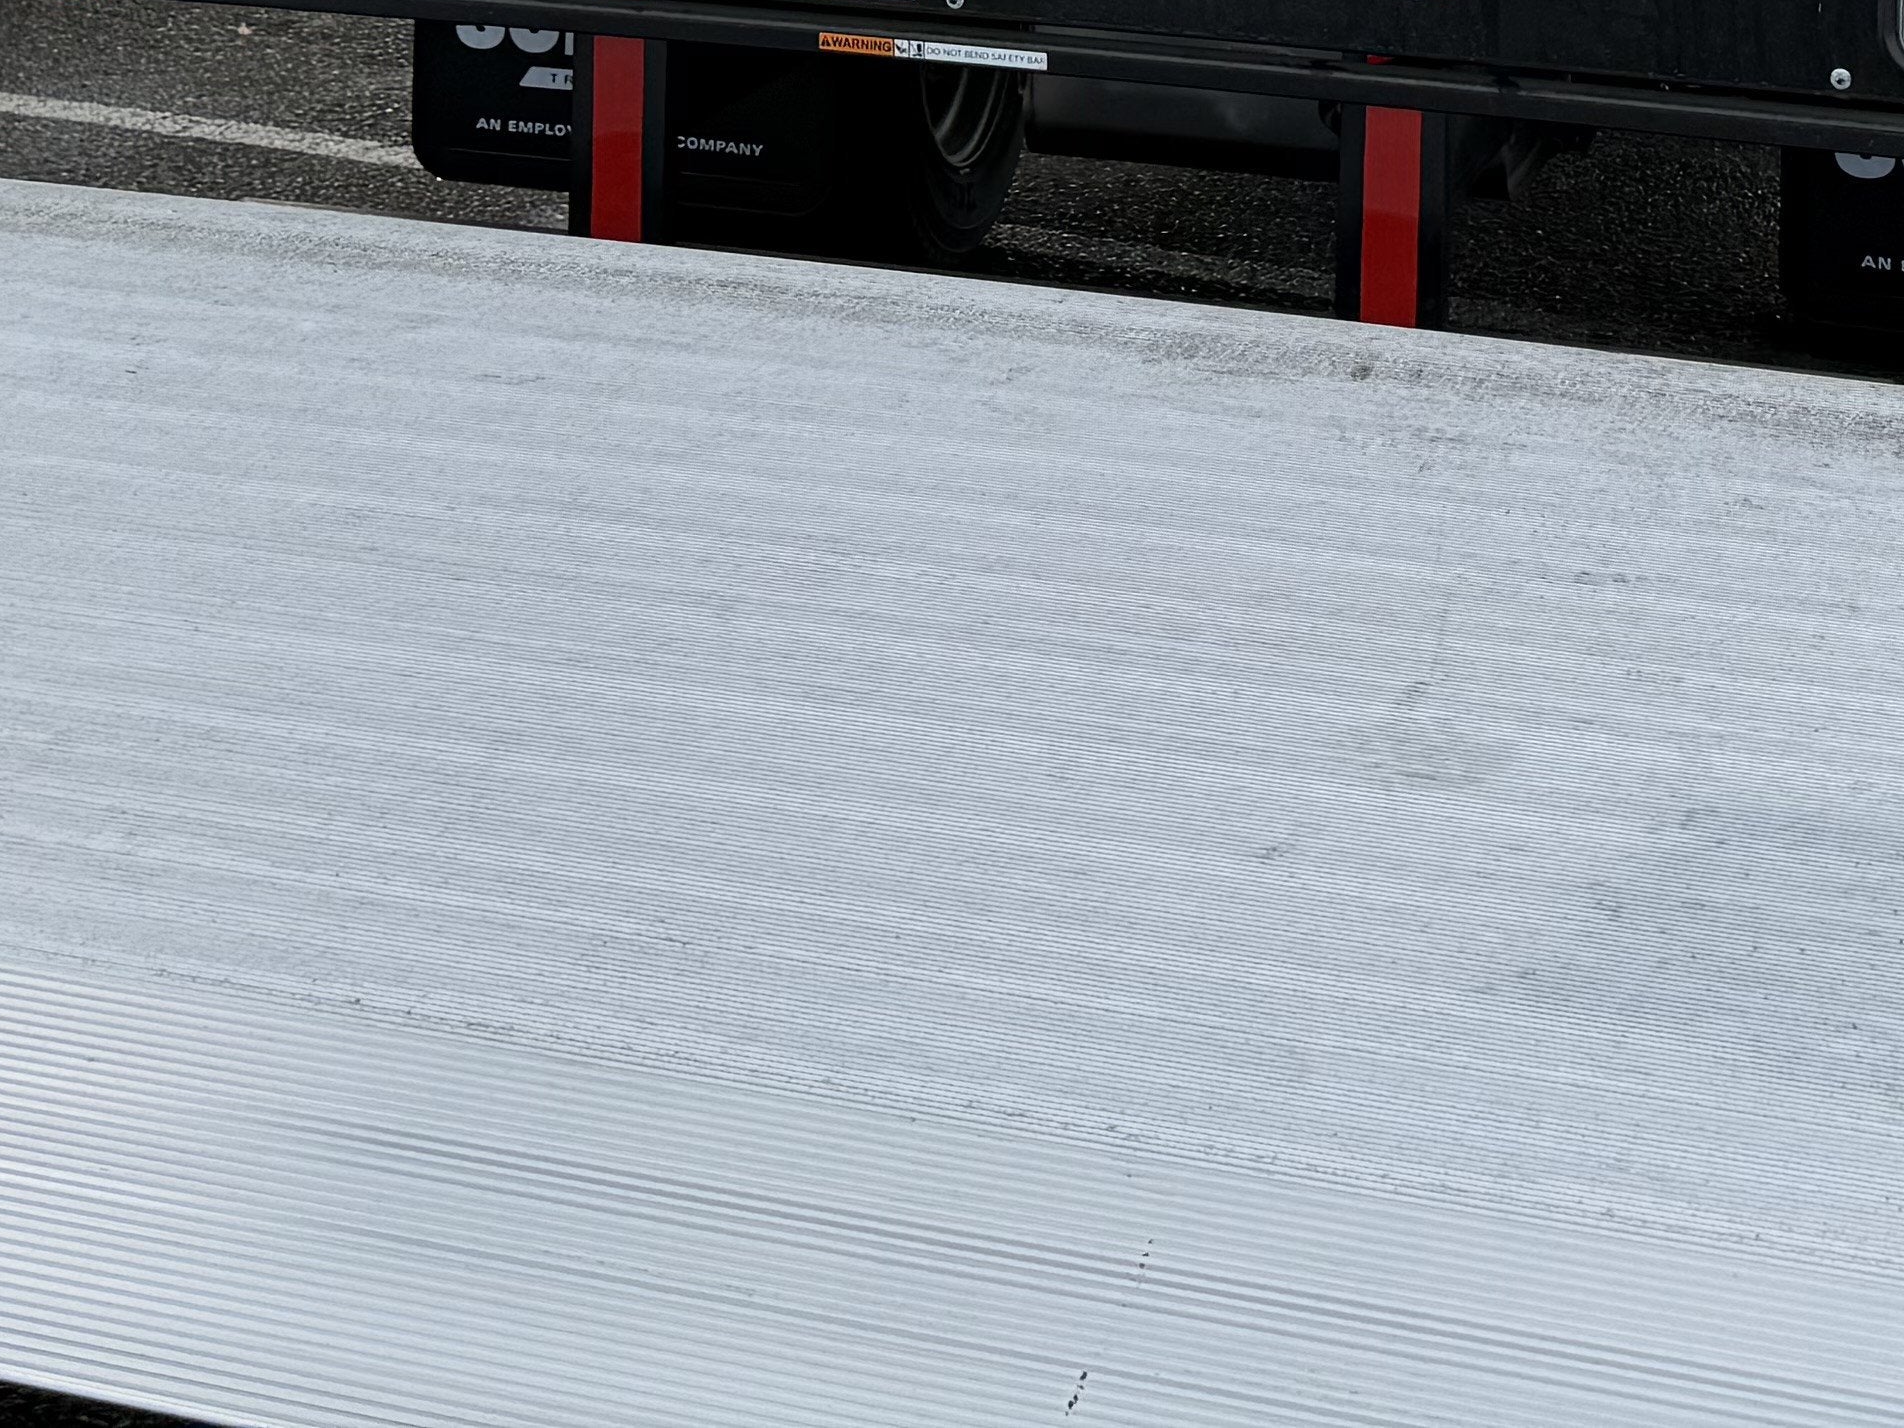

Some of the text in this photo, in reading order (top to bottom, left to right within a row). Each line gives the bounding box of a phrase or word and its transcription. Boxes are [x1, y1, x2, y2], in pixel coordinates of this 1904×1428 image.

[831, 36, 892, 53] WARNING
[926, 46, 941, 56] DO
[943, 48, 962, 58] NOT
[964, 50, 989, 60] BEND
[476, 117, 501, 132] AN
[1861, 255, 1893, 271] AN
